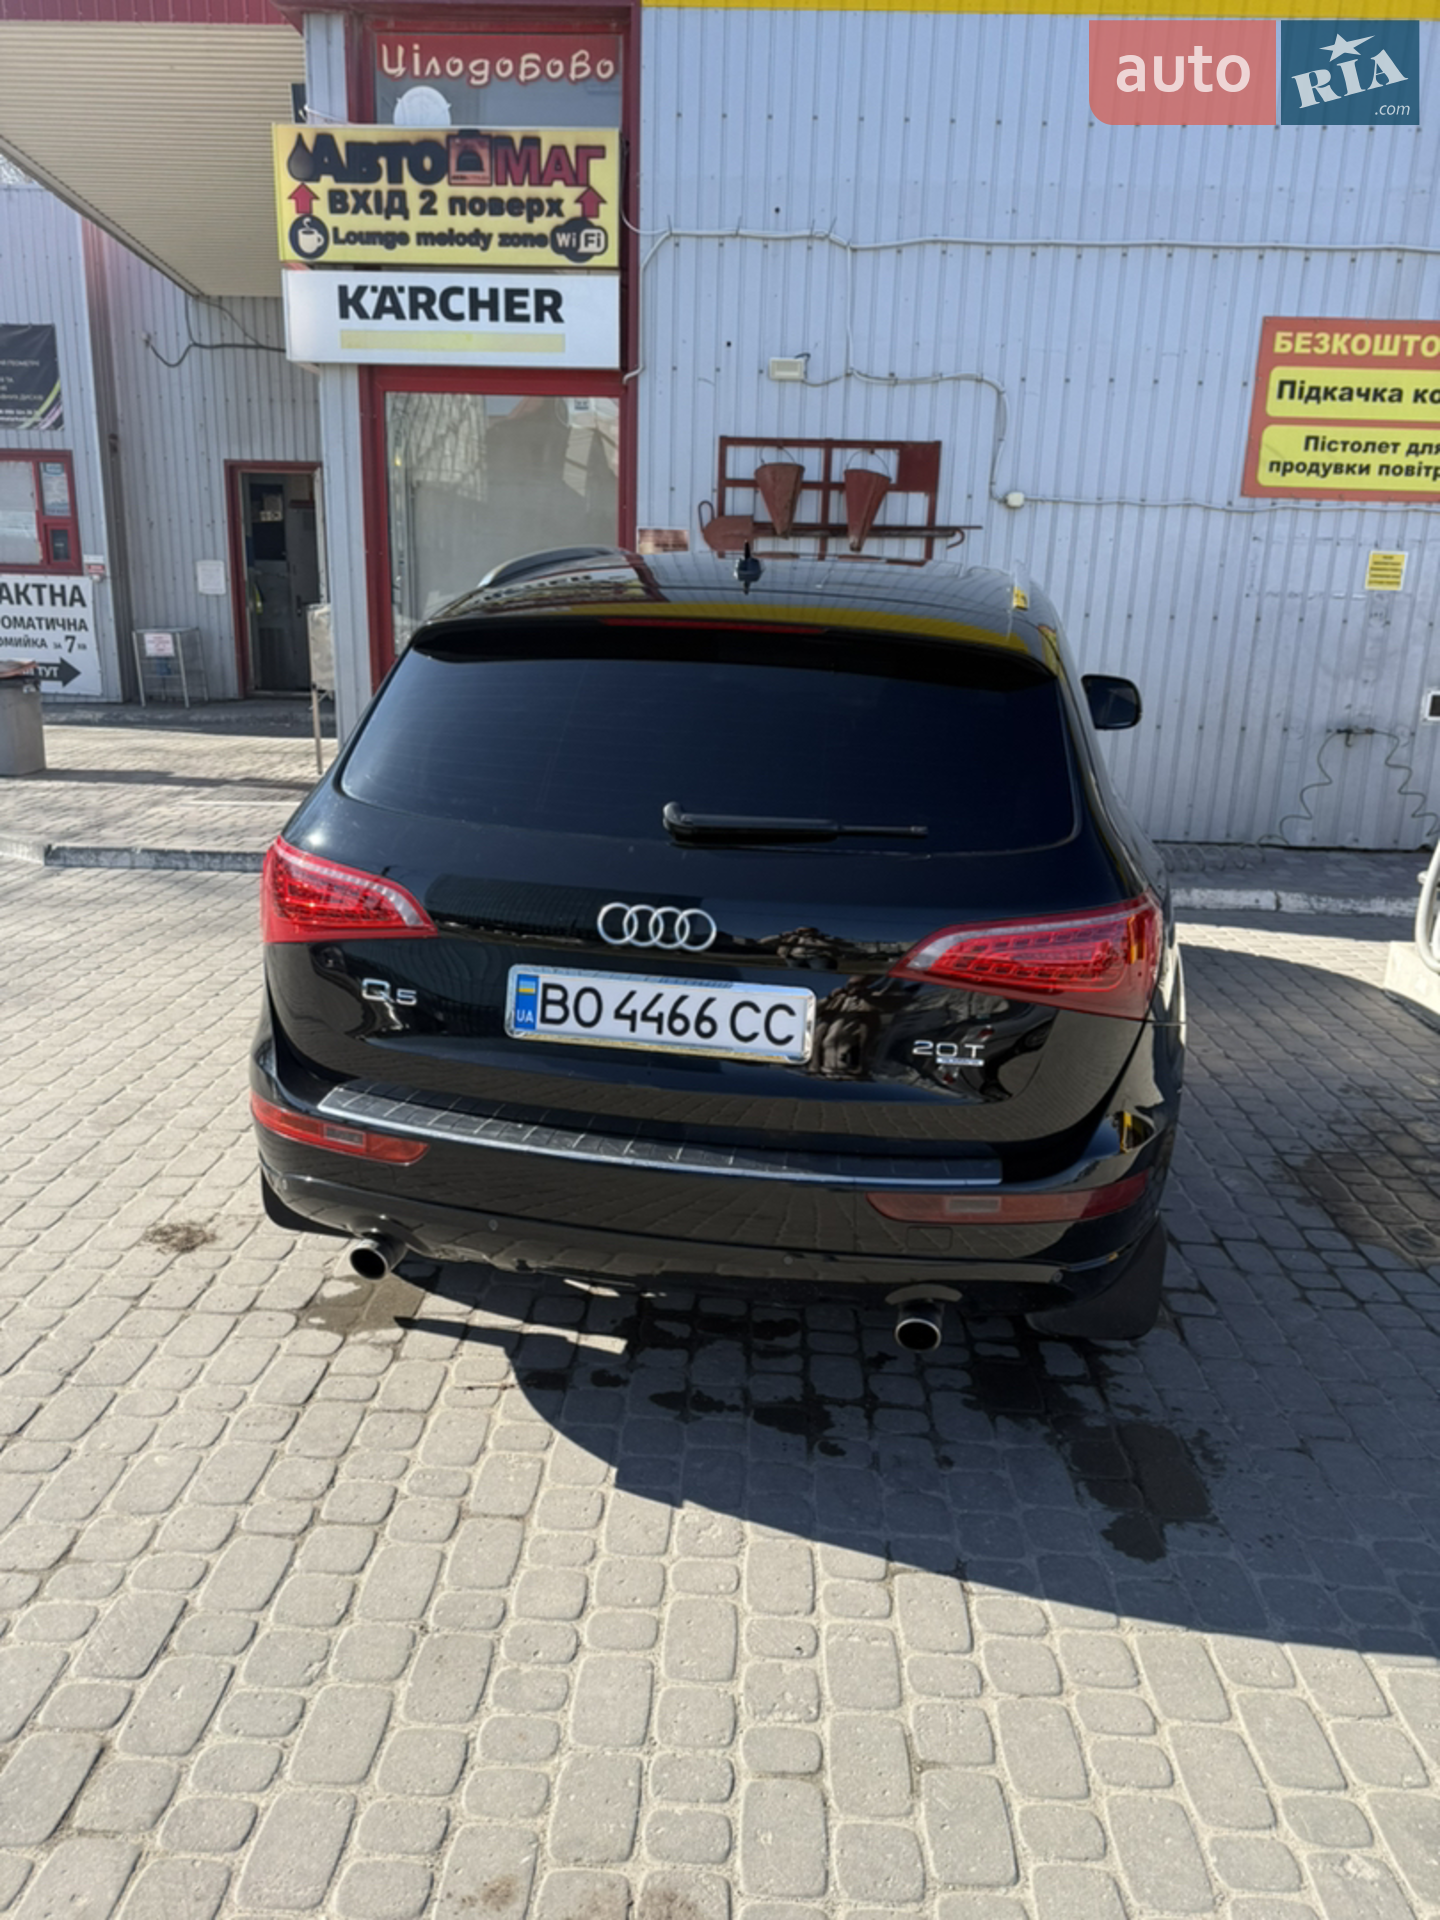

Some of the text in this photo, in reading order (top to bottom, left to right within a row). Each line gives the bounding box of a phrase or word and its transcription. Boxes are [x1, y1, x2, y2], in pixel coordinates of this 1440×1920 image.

[328, 189, 565, 223] ВХІД 2 поверх
[332, 227, 410, 250] Lounge
[416, 228, 492, 251] melody
[498, 233, 549, 248] zone
[337, 285, 564, 323] KÄRCHER
[1273, 331, 1440, 358] БЕЗКОШТО
[1276, 380, 1404, 405] Підкачка
[1304, 435, 1401, 454] Пістолет
[1268, 460, 1371, 478] продувки
[64, 635, 76, 653] 7
[362, 977, 417, 1006] Q5
[516, 1008, 534, 1024] UA
[539, 982, 797, 1046] BO 4466 CC
